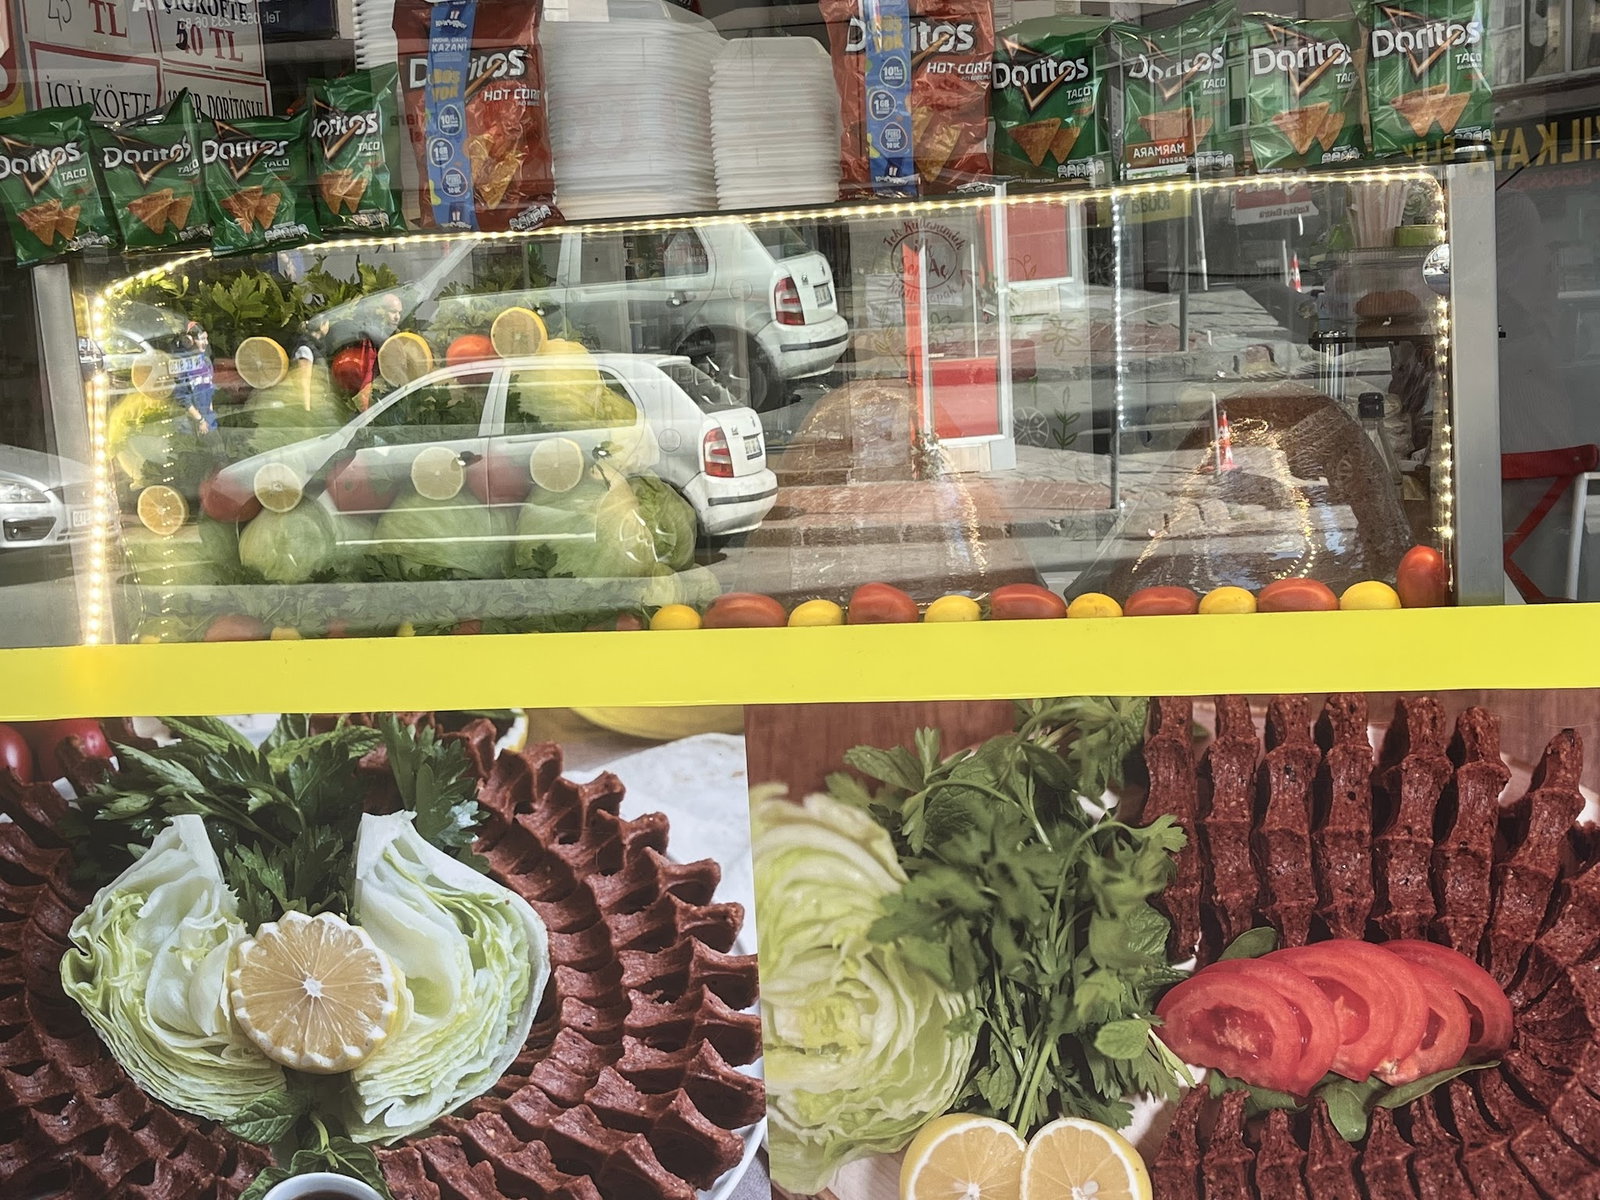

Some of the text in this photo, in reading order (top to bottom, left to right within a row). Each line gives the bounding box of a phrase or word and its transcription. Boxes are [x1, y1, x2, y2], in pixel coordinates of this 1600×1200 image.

[88, 0, 127, 38] TL
[845, 16, 975, 53] Ditos
[1371, 21, 1482, 58] Doritos
[208, 27, 243, 62] TL
[1128, 45, 1225, 84] Doritos
[1455, 52, 1482, 64] TACO
[883, 66, 894, 76] 10
[927, 62, 955, 74] HOT
[991, 57, 1089, 90] Doritos
[1202, 77, 1226, 89] TACO
[484, 89, 511, 101] HOT
[1066, 85, 1092, 100] TACO
[202, 140, 290, 164] Doritos
[359, 141, 380, 152] TACO
[177, 158, 200, 174] TACO
[263, 158, 291, 169] TACO
[60, 168, 88, 181] TACO
